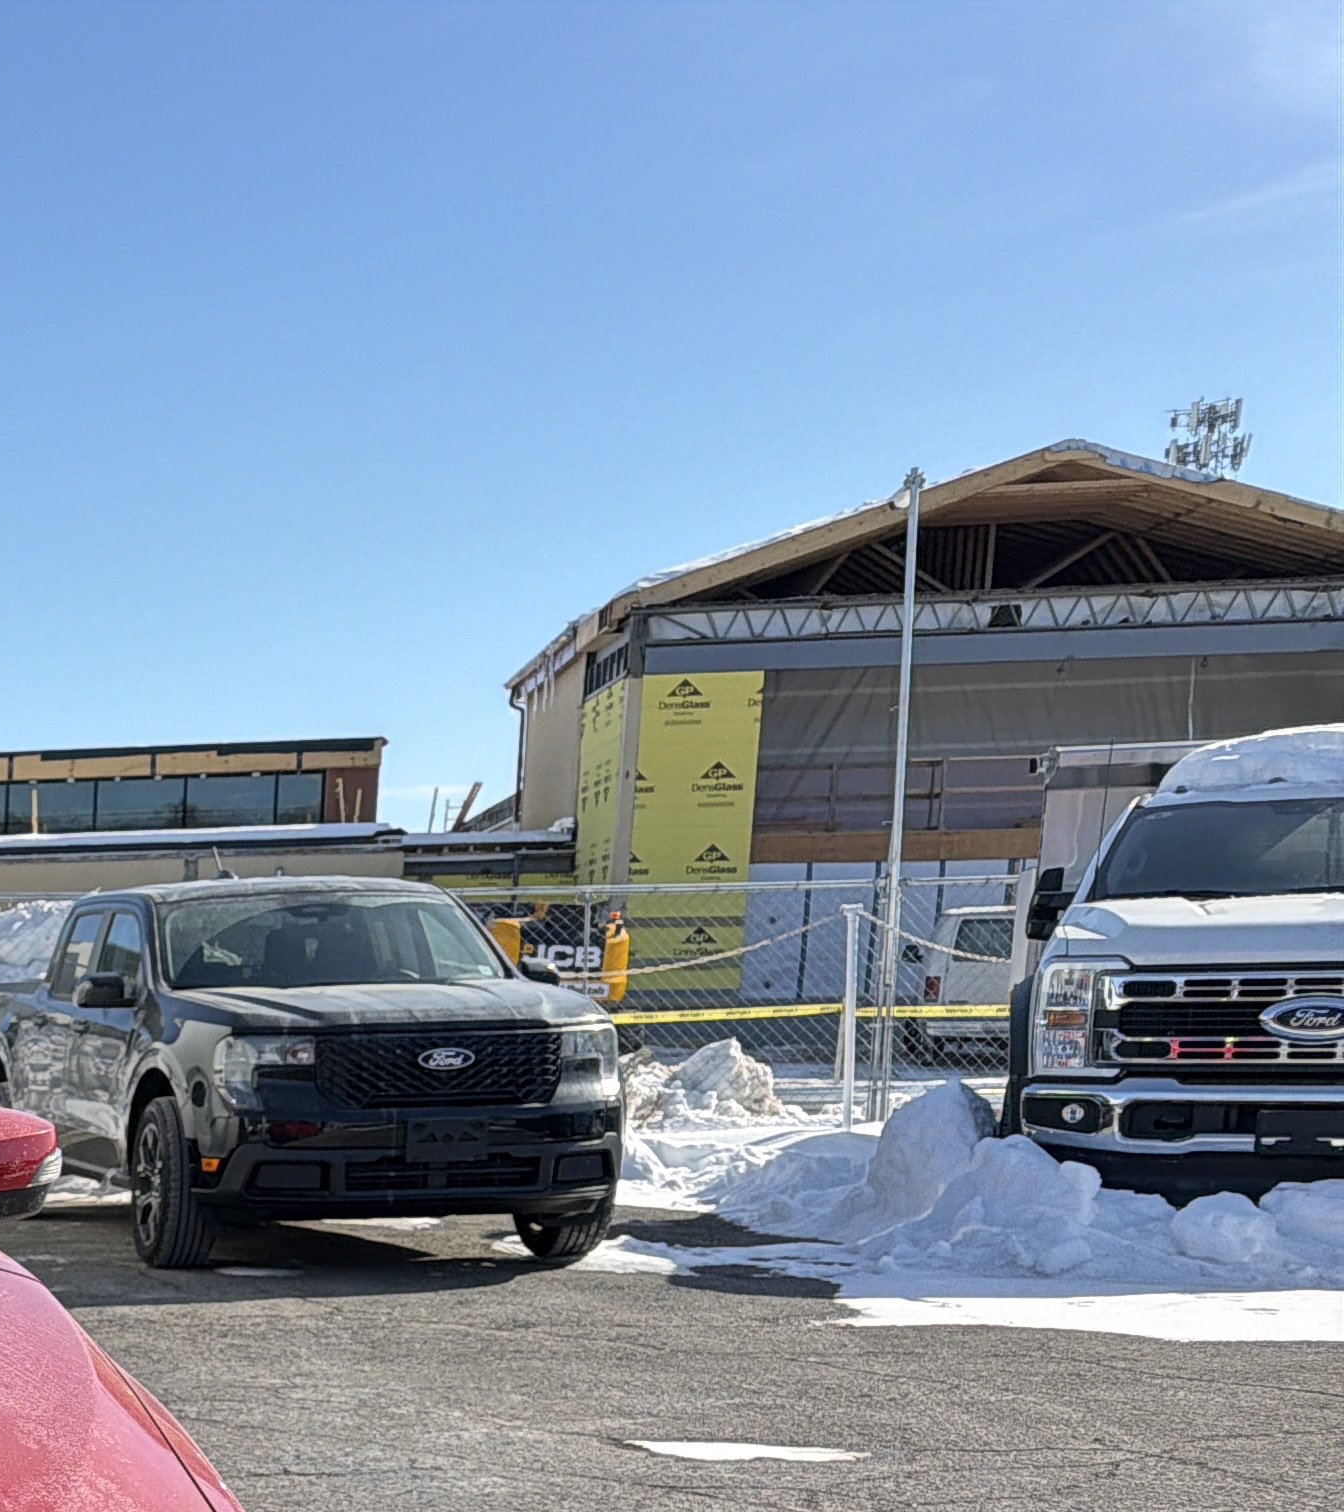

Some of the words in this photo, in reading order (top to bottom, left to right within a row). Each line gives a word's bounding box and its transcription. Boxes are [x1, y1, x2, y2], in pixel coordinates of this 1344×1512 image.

[675, 685, 695, 697] GP
[658, 700, 711, 711] DensGlass
[708, 768, 728, 780] GP
[691, 782, 744, 793] DensGlass
[702, 852, 722, 862] GP
[686, 865, 738, 875] DensGlass
[521, 943, 602, 968] JCB
[1289, 1008, 1343, 1027] Ford
[428, 1051, 465, 1066] Ford
